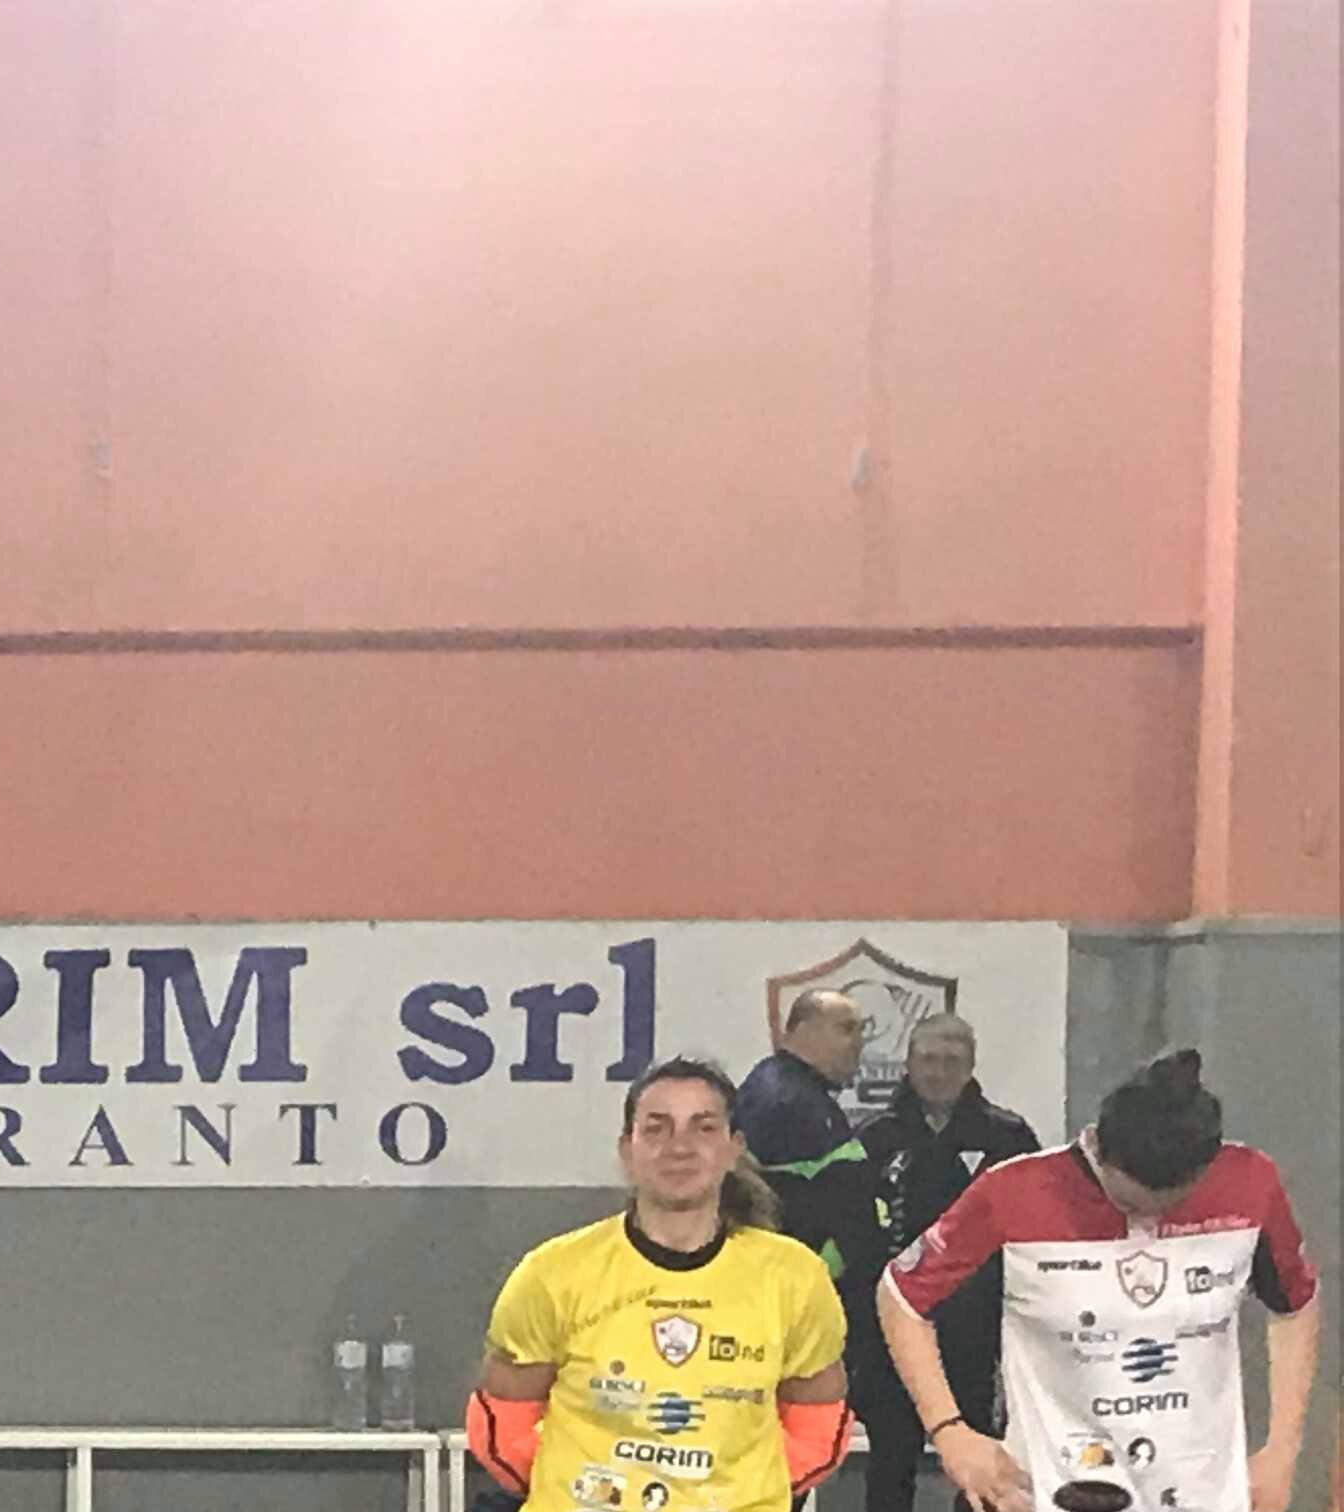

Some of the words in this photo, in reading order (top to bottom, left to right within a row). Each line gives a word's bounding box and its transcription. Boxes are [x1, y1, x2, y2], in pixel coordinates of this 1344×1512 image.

[398, 937, 658, 1084] srl
[1092, 1391, 1189, 1417] CORIM
[614, 1440, 714, 1469] CORIM
